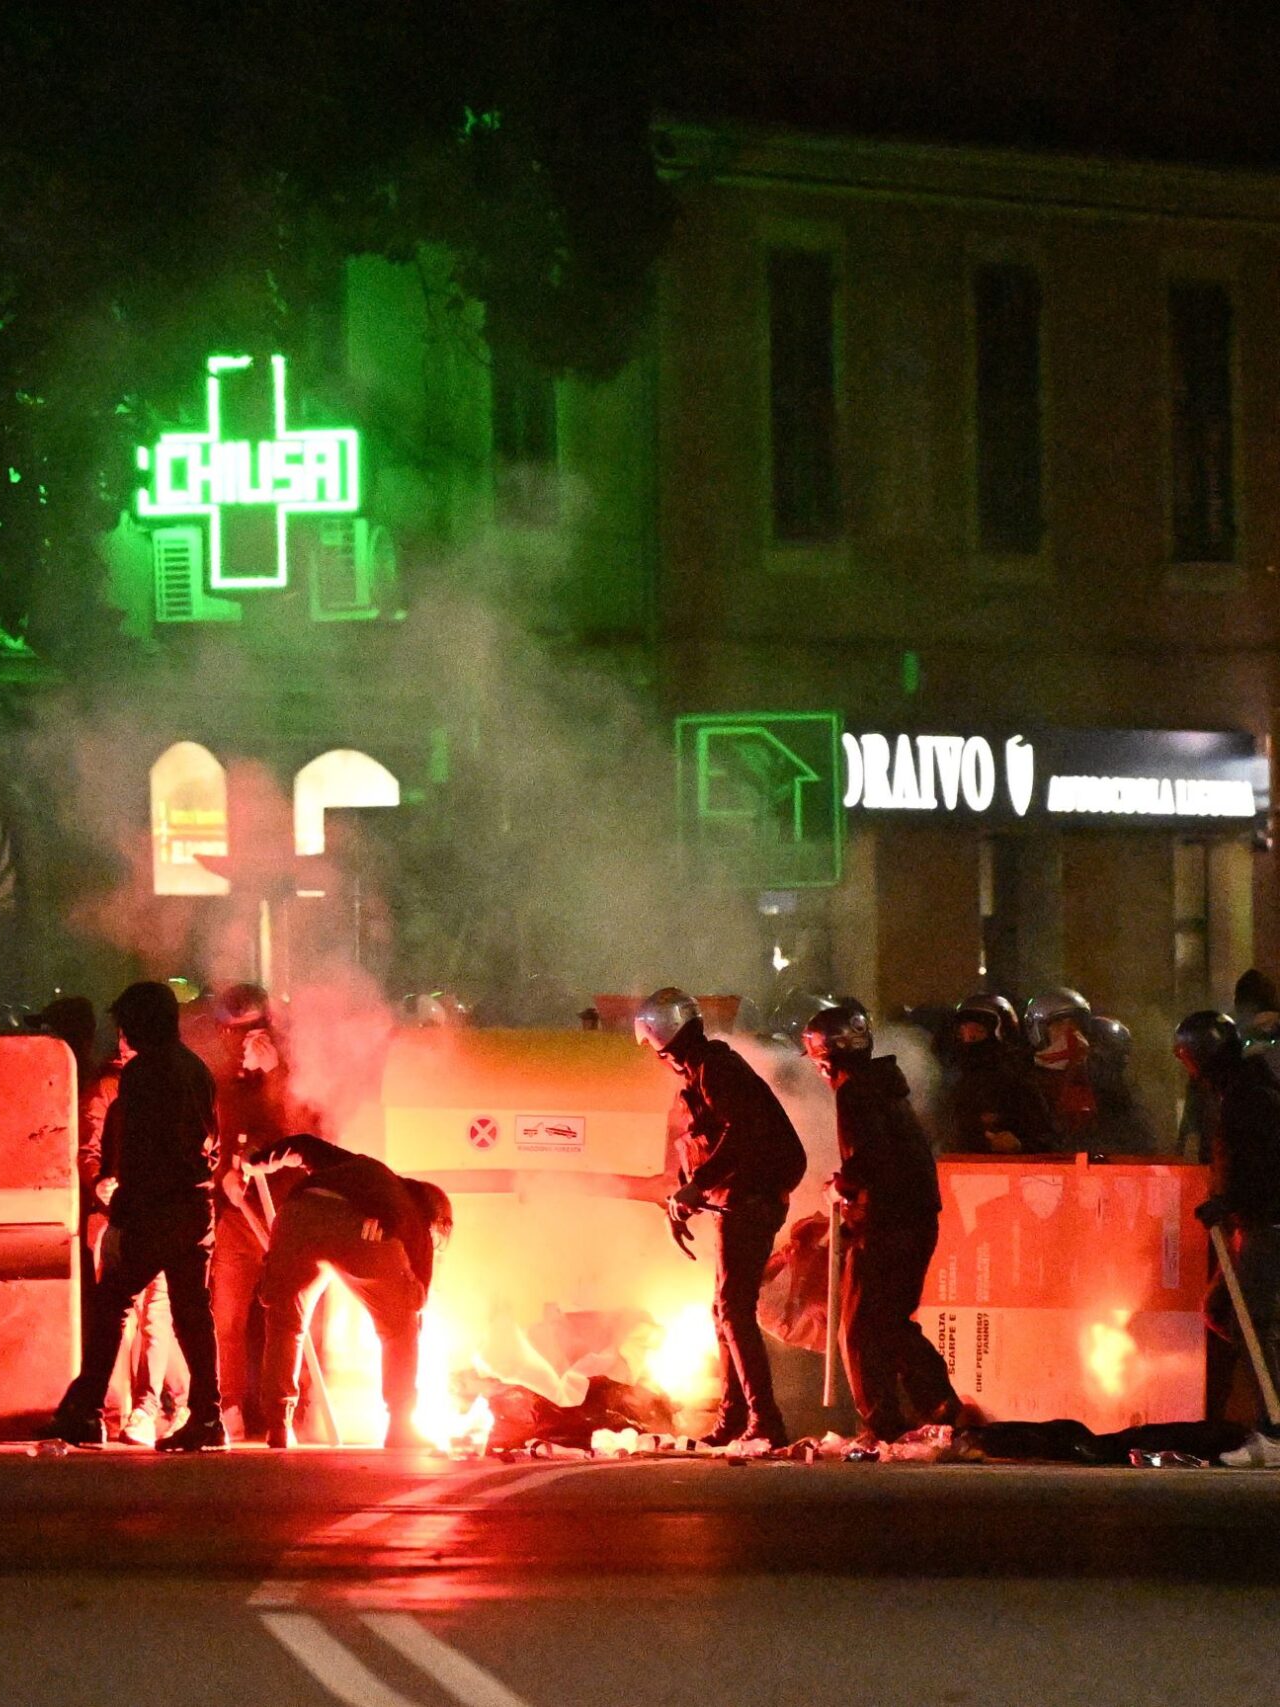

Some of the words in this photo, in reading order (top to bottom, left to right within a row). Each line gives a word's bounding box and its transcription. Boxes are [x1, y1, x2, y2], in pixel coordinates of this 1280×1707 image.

[156, 440, 340, 503] CHIUSA
[938, 1312, 946, 1357] CCOLTA
[948, 1314, 956, 1322] E
[948, 1326, 957, 1375] SCARPE
